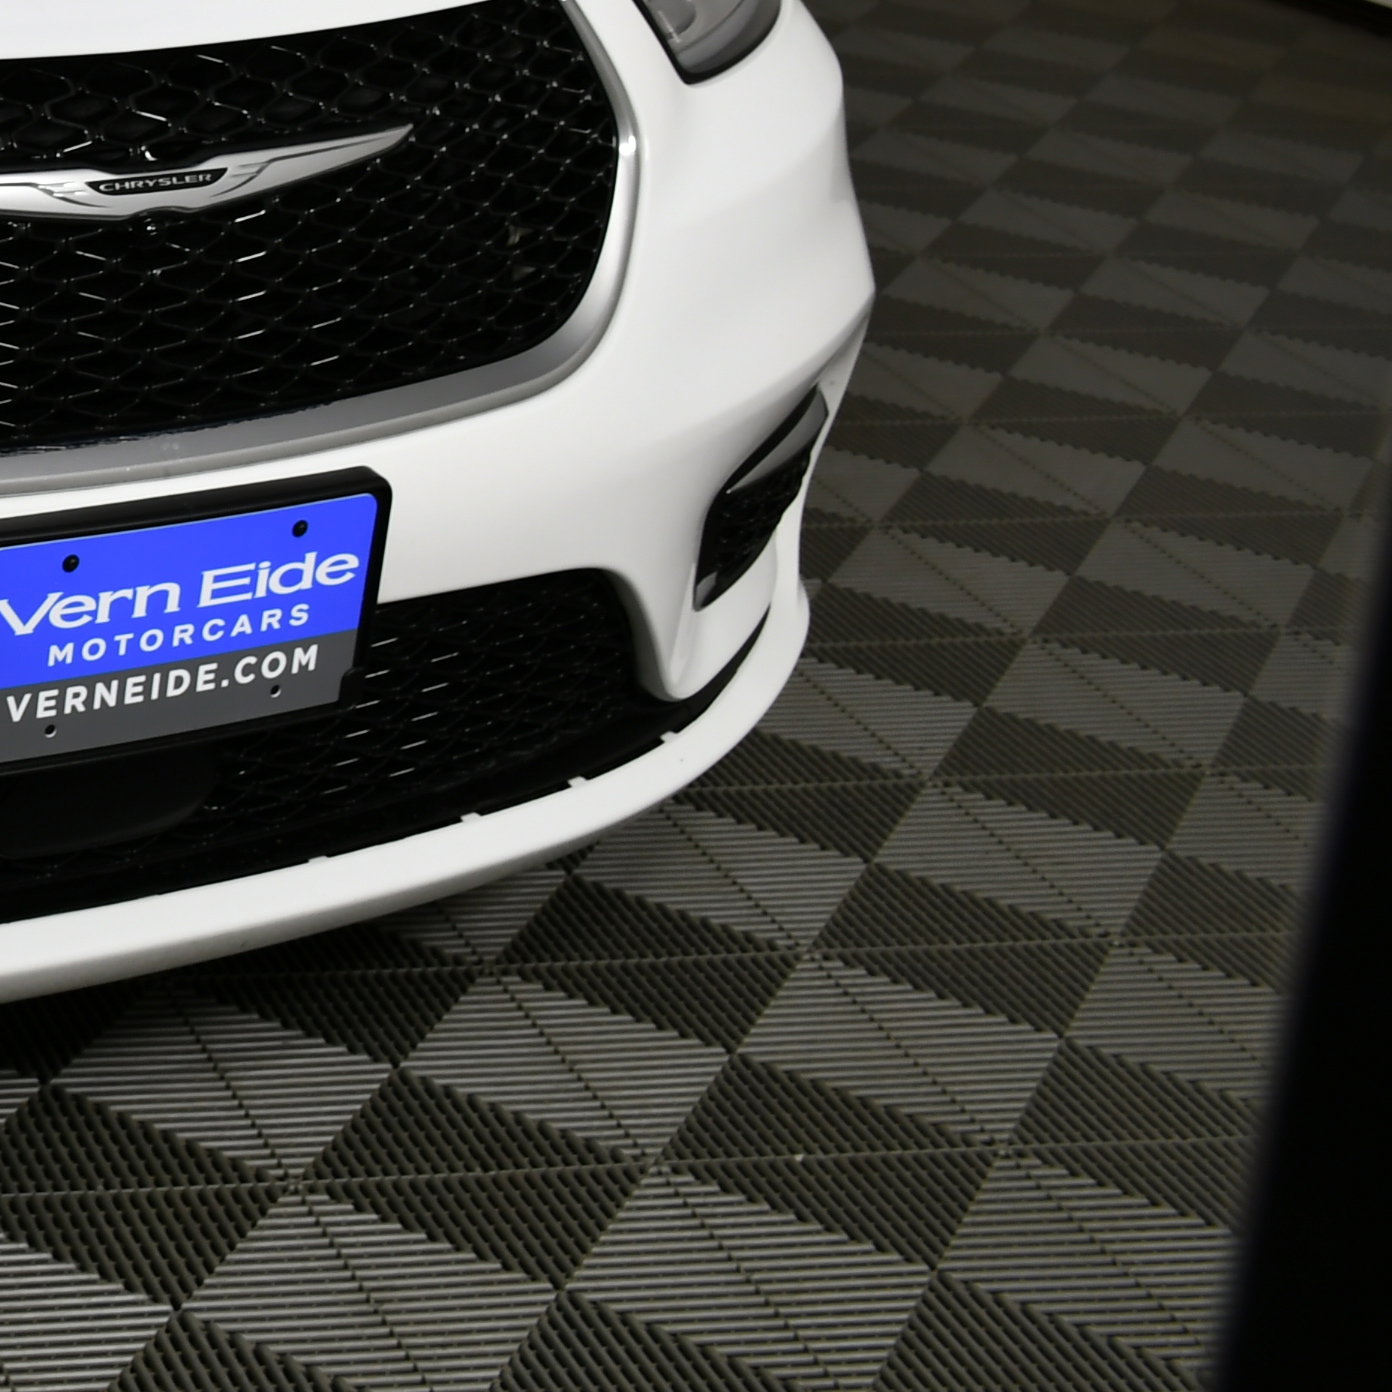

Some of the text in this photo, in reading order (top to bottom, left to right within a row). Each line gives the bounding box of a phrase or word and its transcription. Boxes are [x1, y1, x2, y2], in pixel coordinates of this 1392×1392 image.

[98, 173, 212, 192] CHRYSLER
[197, 551, 359, 608] Eide
[47, 603, 311, 667] MOTORCARS
[5, 644, 319, 723] VERNEIDE.COM
